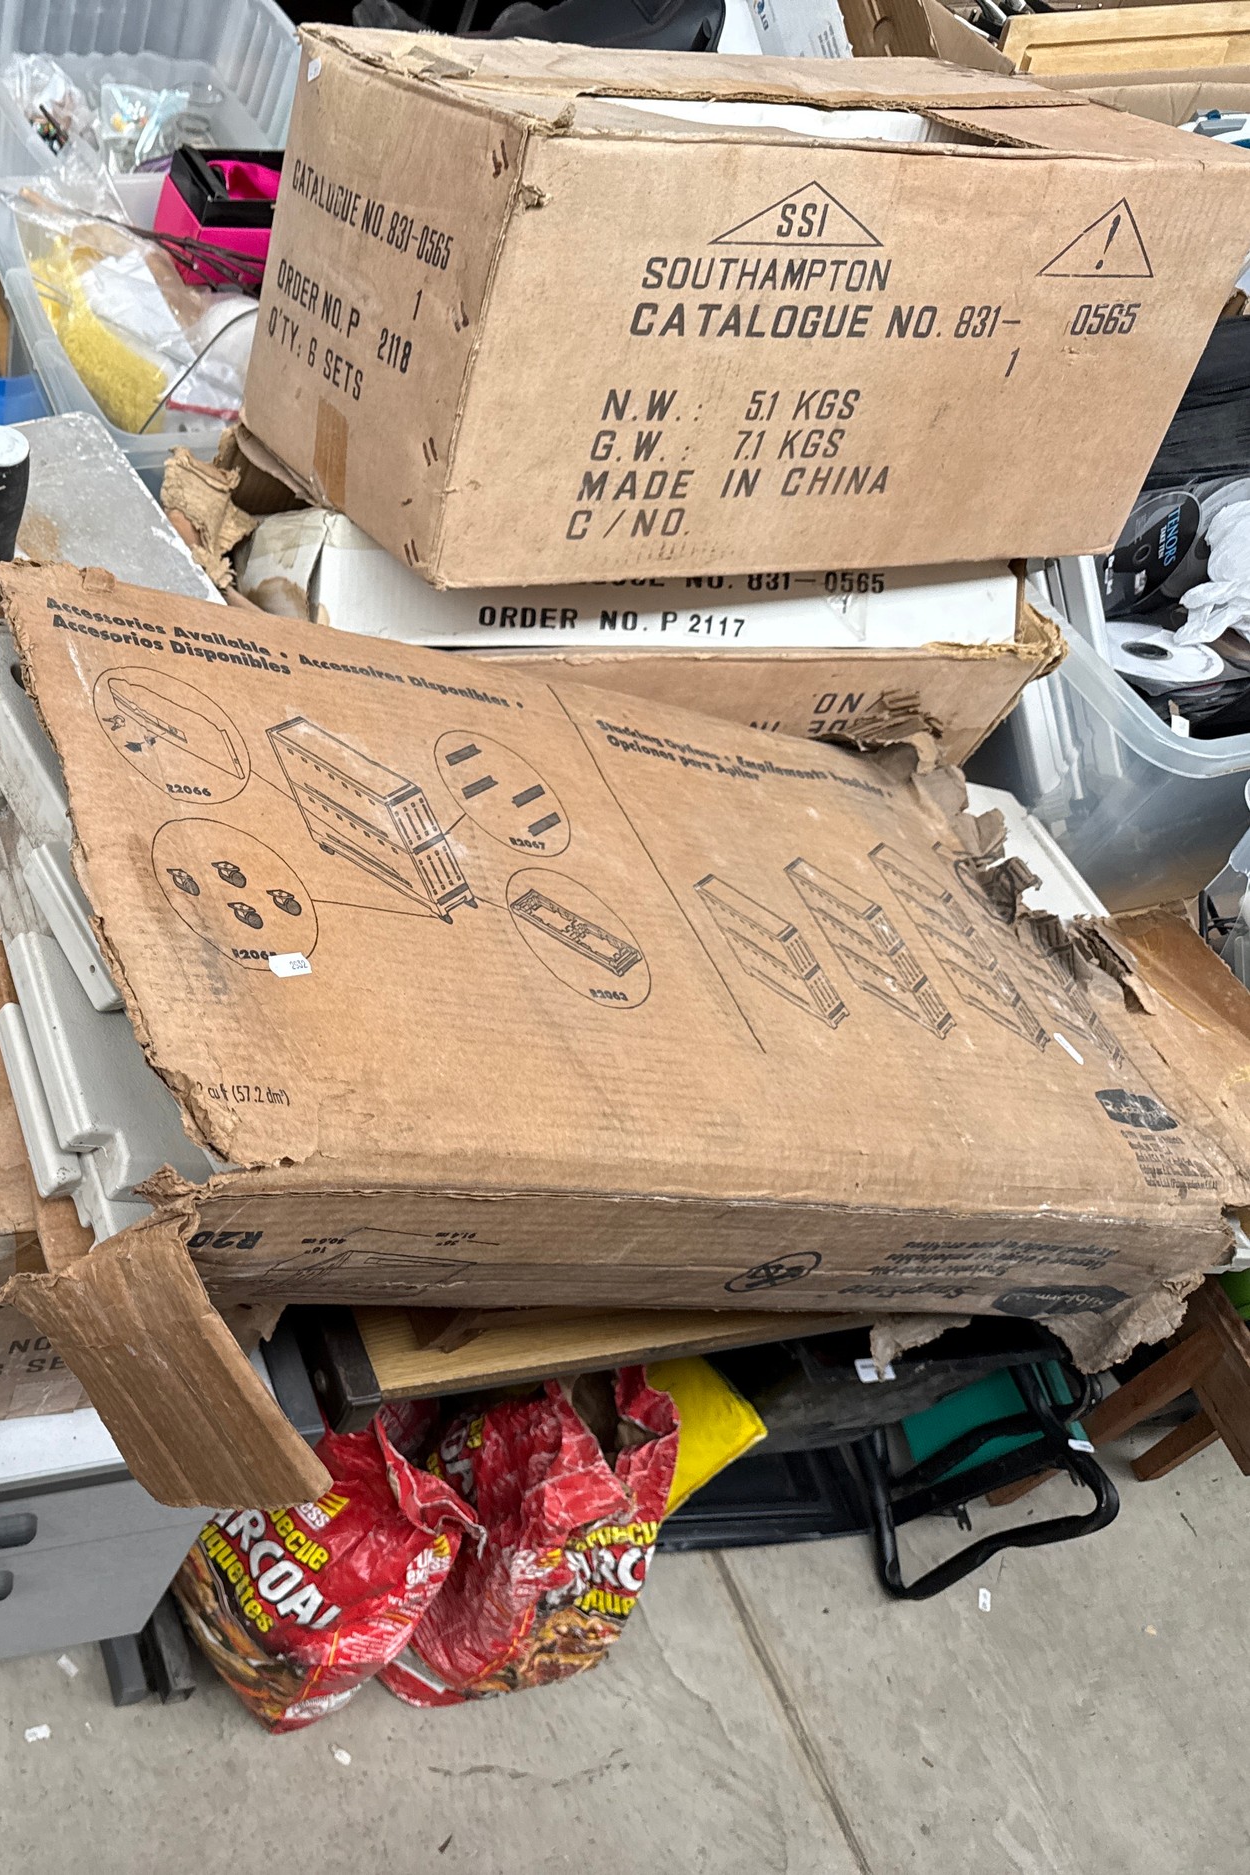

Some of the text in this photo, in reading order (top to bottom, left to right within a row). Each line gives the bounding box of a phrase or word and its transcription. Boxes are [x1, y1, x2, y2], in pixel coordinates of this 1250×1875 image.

[361, 198, 384, 242] NO.
[386, 211, 454, 271] 831-0565
[776, 203, 830, 239] SSI
[641, 256, 892, 293] SOUTHAMPTON
[277, 259, 413, 374] ORDER NO. P 2118
[629, 302, 1142, 339] CATALOGUE NO. 831- 0565
[307, 337, 318, 367] 6
[323, 348, 364, 401] SETS
[792, 388, 861, 421] KGS
[778, 428, 846, 460] KGS
[576, 465, 890, 501] MADE IN CHINA
[1163, 506, 1181, 567] TENORS
[478, 606, 746, 638] ORDER NO. P 2117
[47, 597, 510, 708] Accessories Available Accessoires Disponibles
[52, 614, 290, 676] Accesorios Disponibles
[606, 734, 676, 762] Opciones
[679, 752, 712, 771] para
[166, 783, 211, 796] R2066
[509, 837, 545, 850] R2067
[232, 1085, 265, 1103] (57.2
[200, 1523, 274, 1633] iquettes
